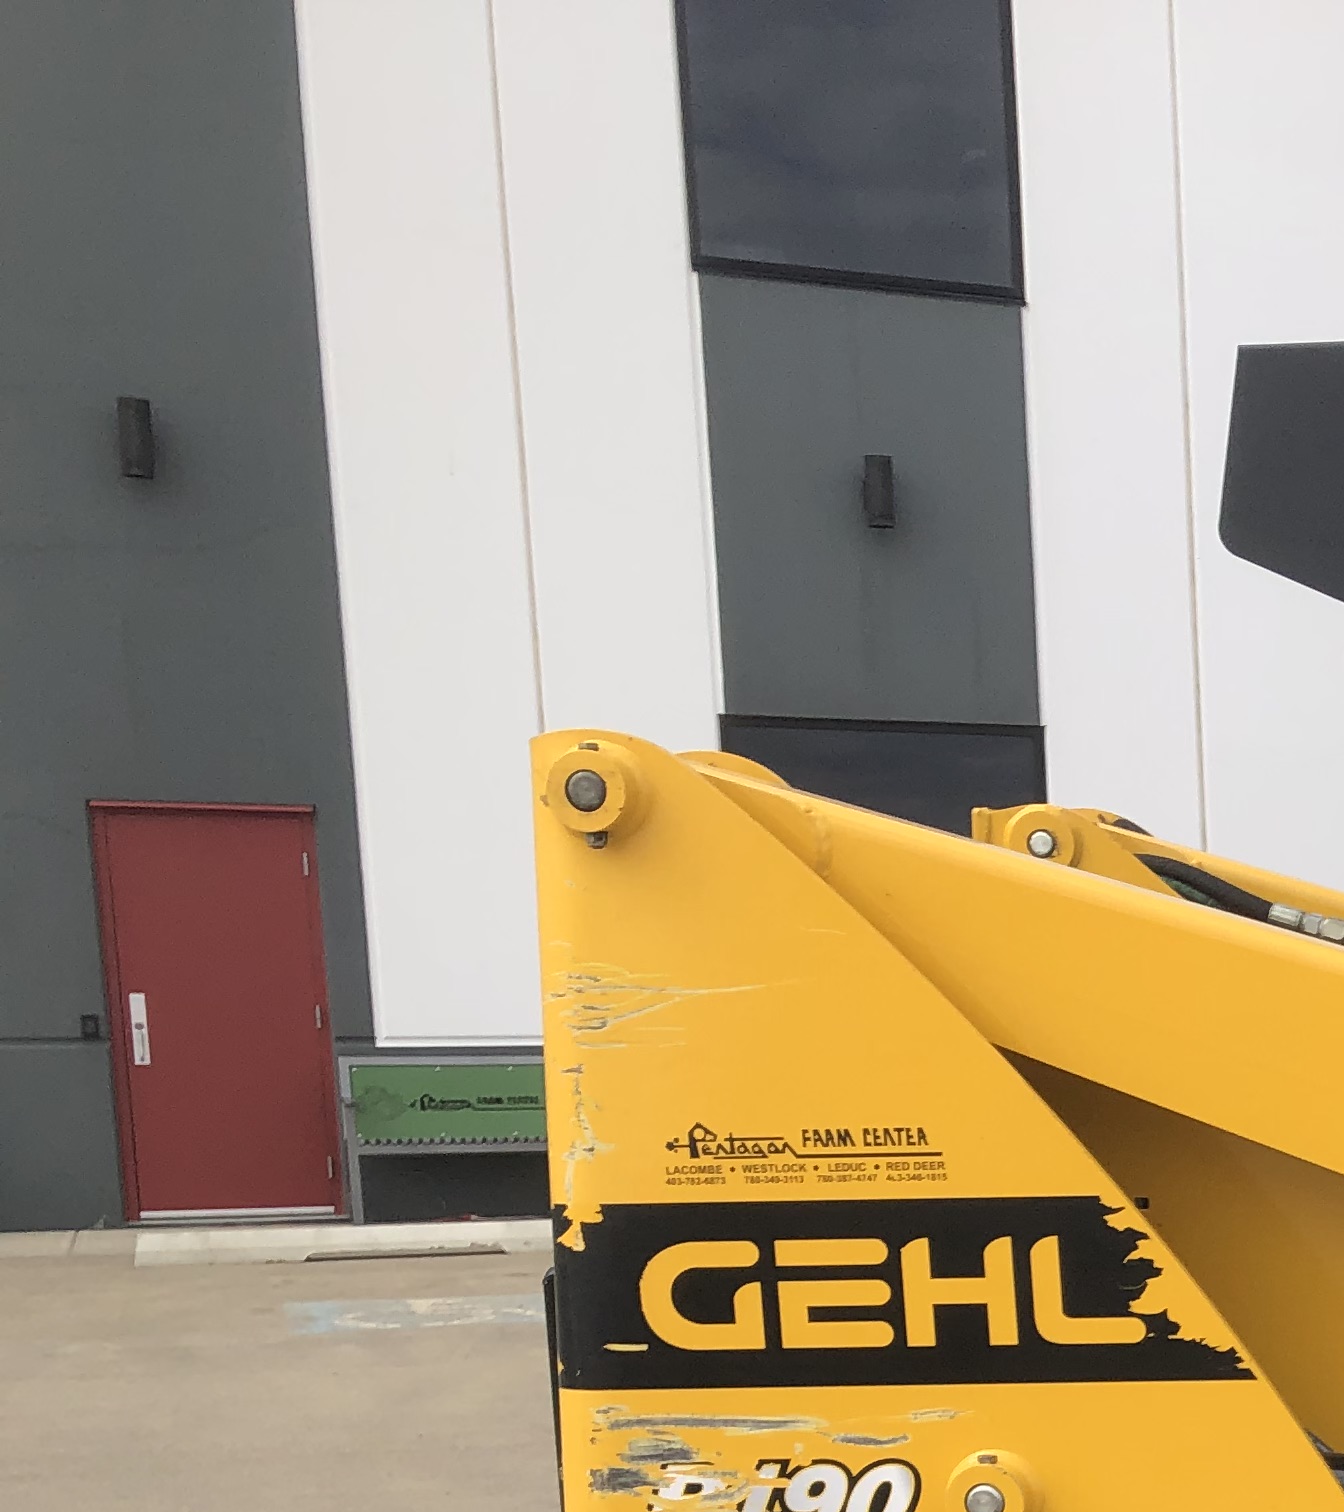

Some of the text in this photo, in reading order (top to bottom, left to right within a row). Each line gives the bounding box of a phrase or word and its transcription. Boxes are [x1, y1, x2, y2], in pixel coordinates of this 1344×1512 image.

[665, 1161, 946, 1175] LACOMBE WESTLOCK LEDUC RED DEER
[639, 1235, 1147, 1351] GEHL
